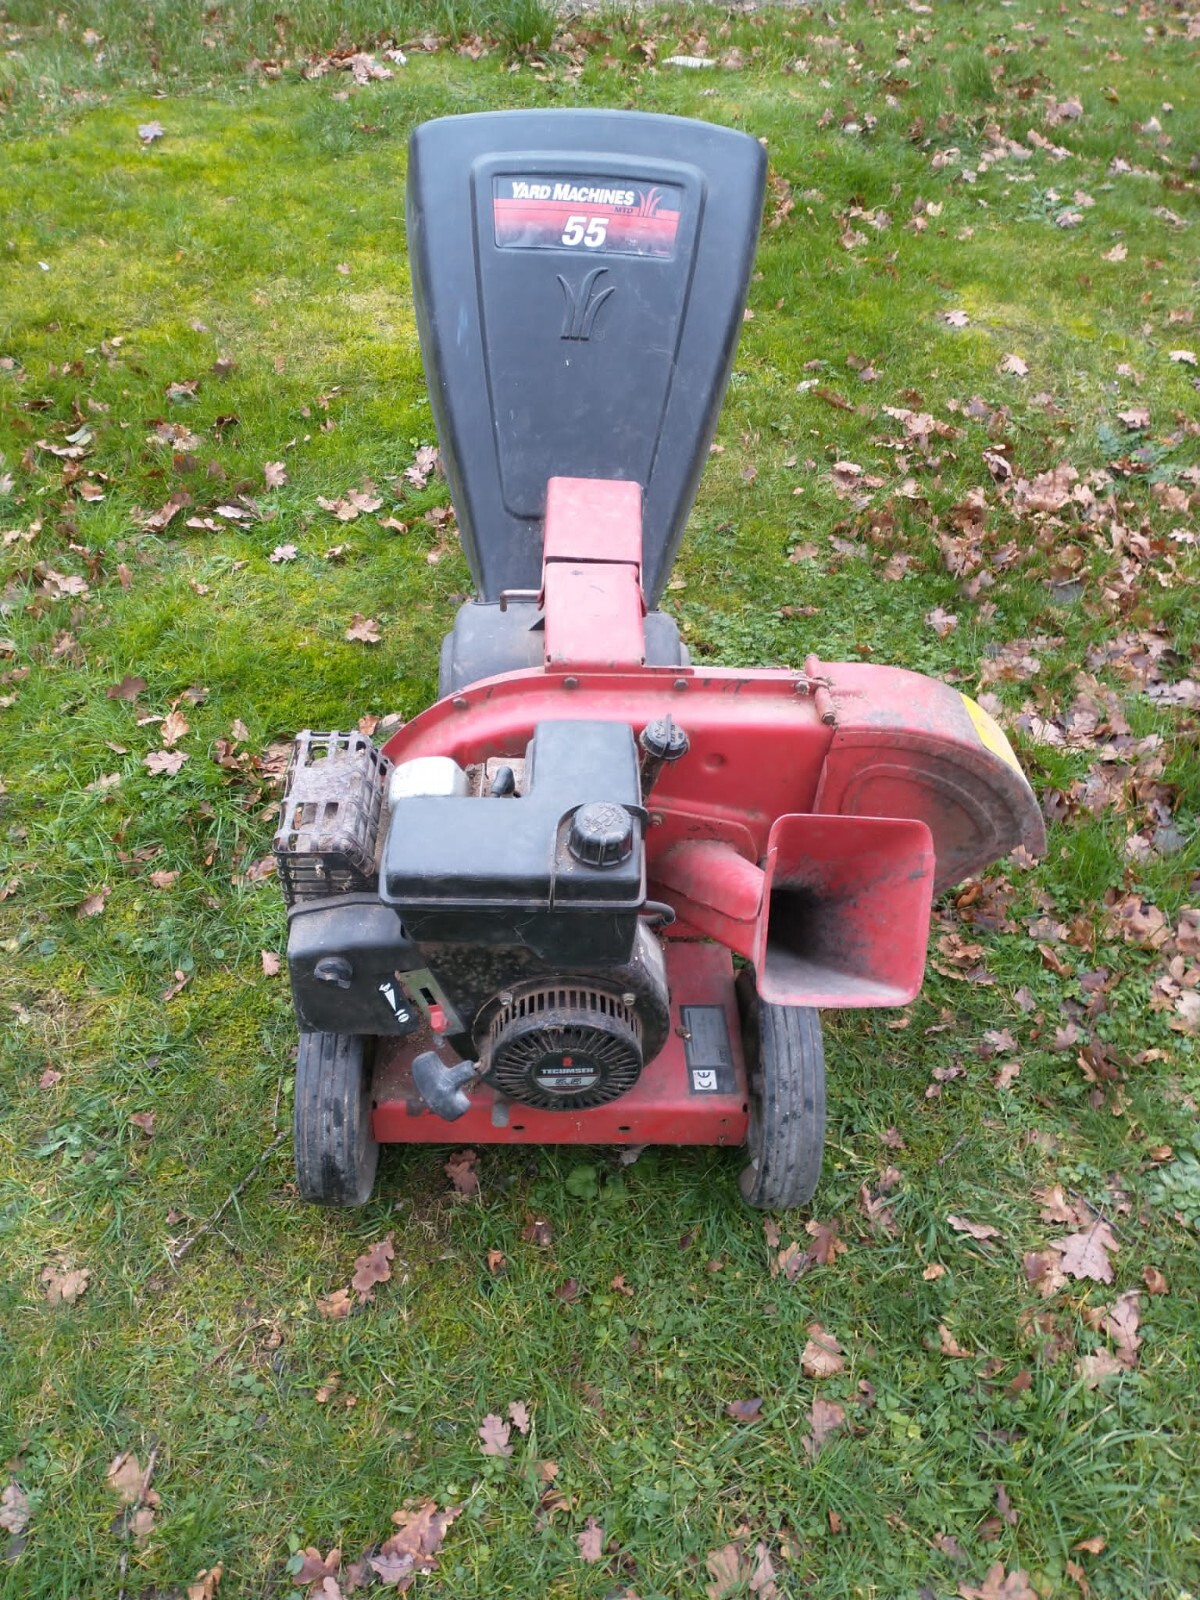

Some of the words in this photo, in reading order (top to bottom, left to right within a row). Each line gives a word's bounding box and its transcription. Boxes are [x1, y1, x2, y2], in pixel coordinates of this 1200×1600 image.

[512, 182, 550, 199] YARD
[552, 183, 634, 206] MACHINES
[614, 206, 634, 214] MTD
[561, 216, 609, 247] 55
[541, 1067, 594, 1075] TECUMSEH
